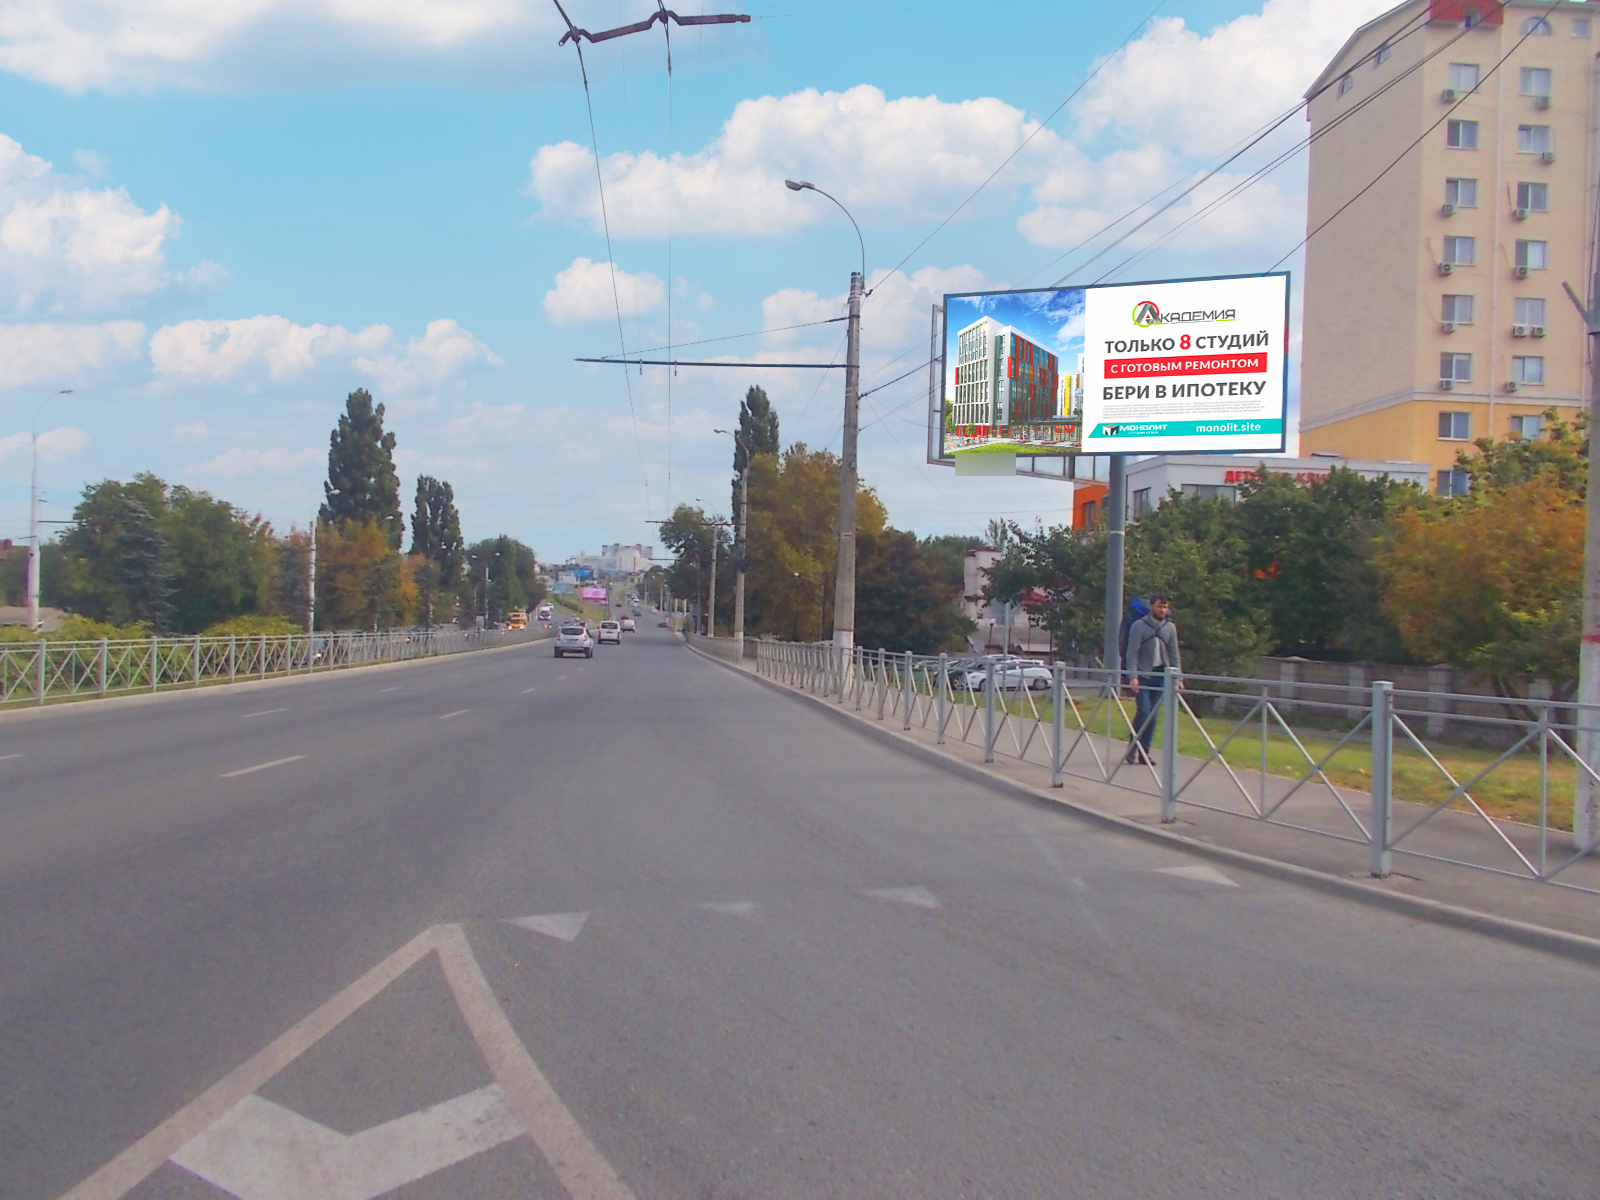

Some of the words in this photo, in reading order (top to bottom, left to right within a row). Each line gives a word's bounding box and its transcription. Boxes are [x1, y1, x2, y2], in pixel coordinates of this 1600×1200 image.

[1133, 302, 1236, 325] АКАДЕМИЯ
[1105, 338, 1175, 353] ТОЛЬКО
[1179, 334, 1191, 350] 8
[1196, 331, 1269, 349] СТУДИЙ
[1110, 364, 1118, 374] С
[1120, 361, 1182, 373] ГОТОВЫМ
[1185, 359, 1259, 371] РЕМОНТОМ
[1103, 385, 1150, 400] БЕРИ
[1155, 384, 1167, 398] В
[1172, 381, 1267, 397] ИПОТЕКУ
[1119, 424, 1168, 432] МОНОЛИТ
[1196, 422, 1261, 433] monolit.site
